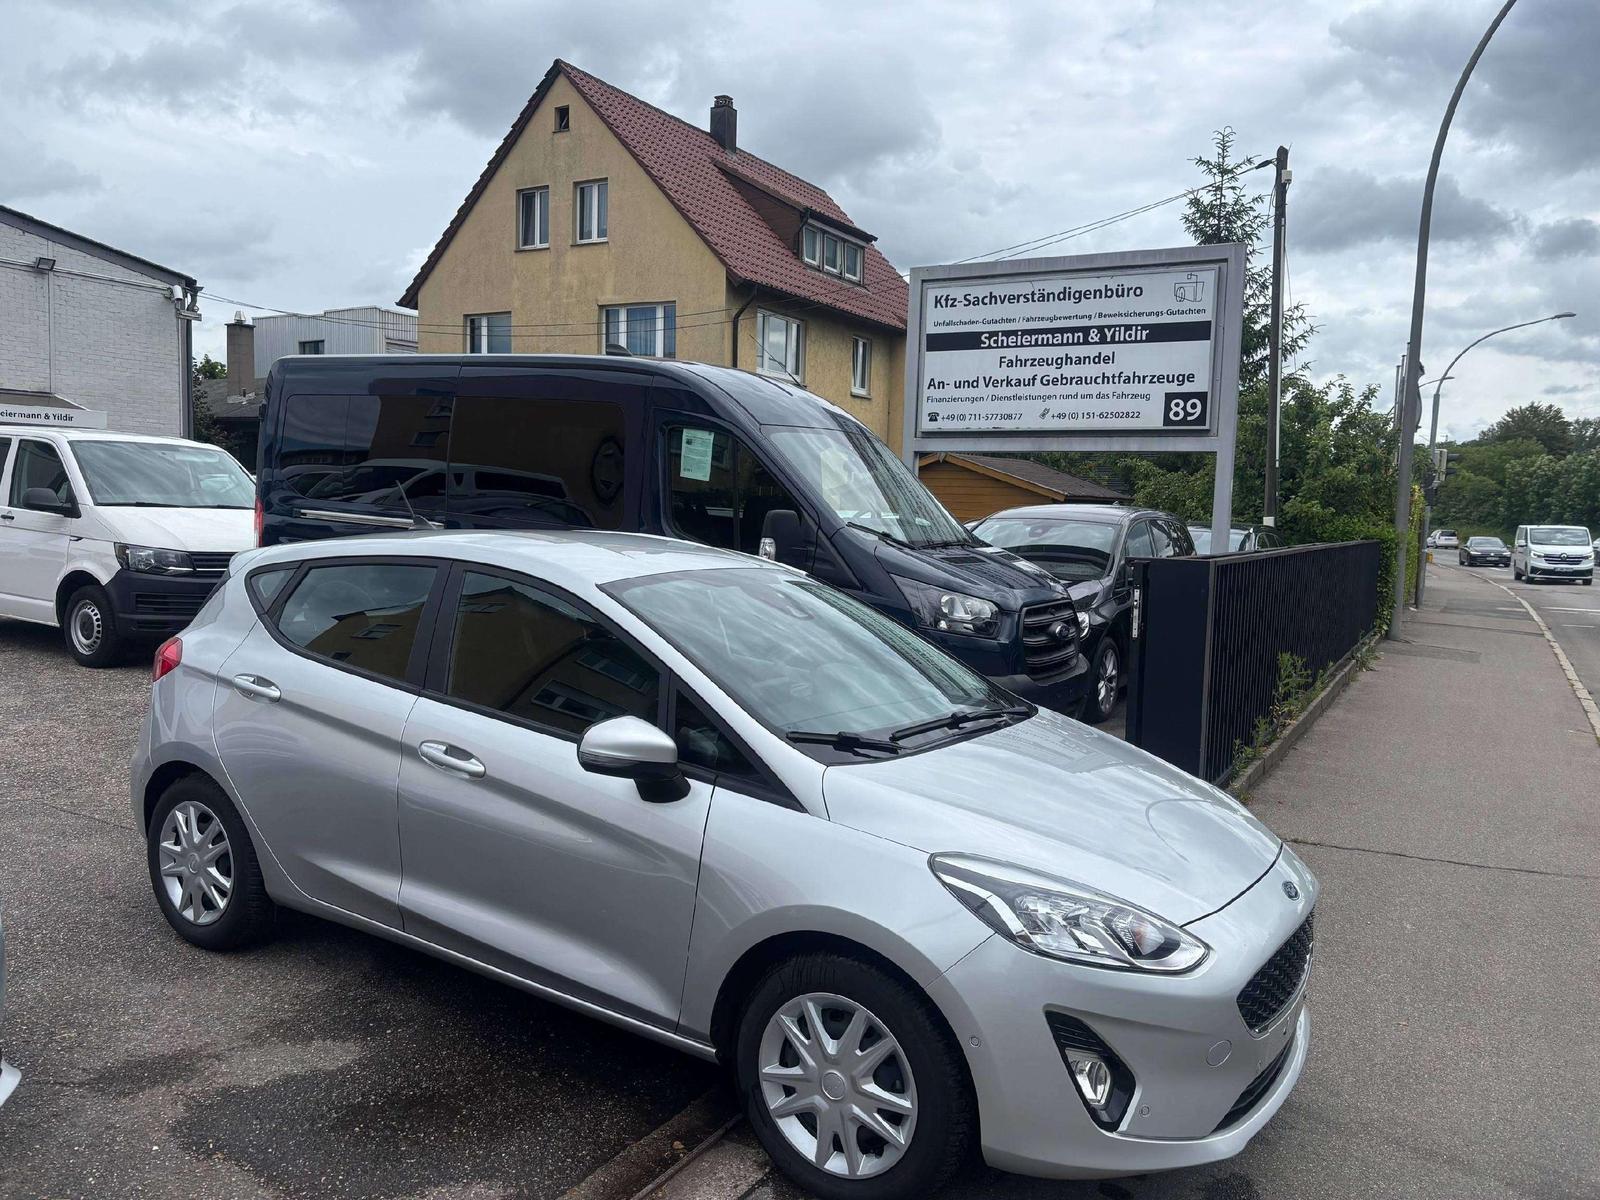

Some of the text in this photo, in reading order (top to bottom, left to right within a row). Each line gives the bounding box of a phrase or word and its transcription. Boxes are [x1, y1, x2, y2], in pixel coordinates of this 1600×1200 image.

[934, 284, 1143, 309] Kfz-Sachverständigenbüro
[933, 317, 1017, 327] Unfallschaden-Gutachten
[980, 326, 1149, 347] Scheiermann & Yildir
[999, 351, 1115, 369] Fahrzeughandel
[927, 371, 1195, 390] An- und Verkauf Gebrauchtfahrzeuge
[926, 395, 984, 404] Finanzierungen
[991, 393, 1057, 403] Dienstleistungen
[1059, 392, 1078, 400] rund
[1095, 391, 1110, 400] das
[1112, 391, 1151, 402] Fahrzeug
[43, 412, 51, 421] &
[52, 413, 74, 422] Yildir
[1051, 411, 1141, 421] +49 (0) 151-62502822
[1169, 399, 1202, 420] 89
[941, 414, 955, 422] +49
